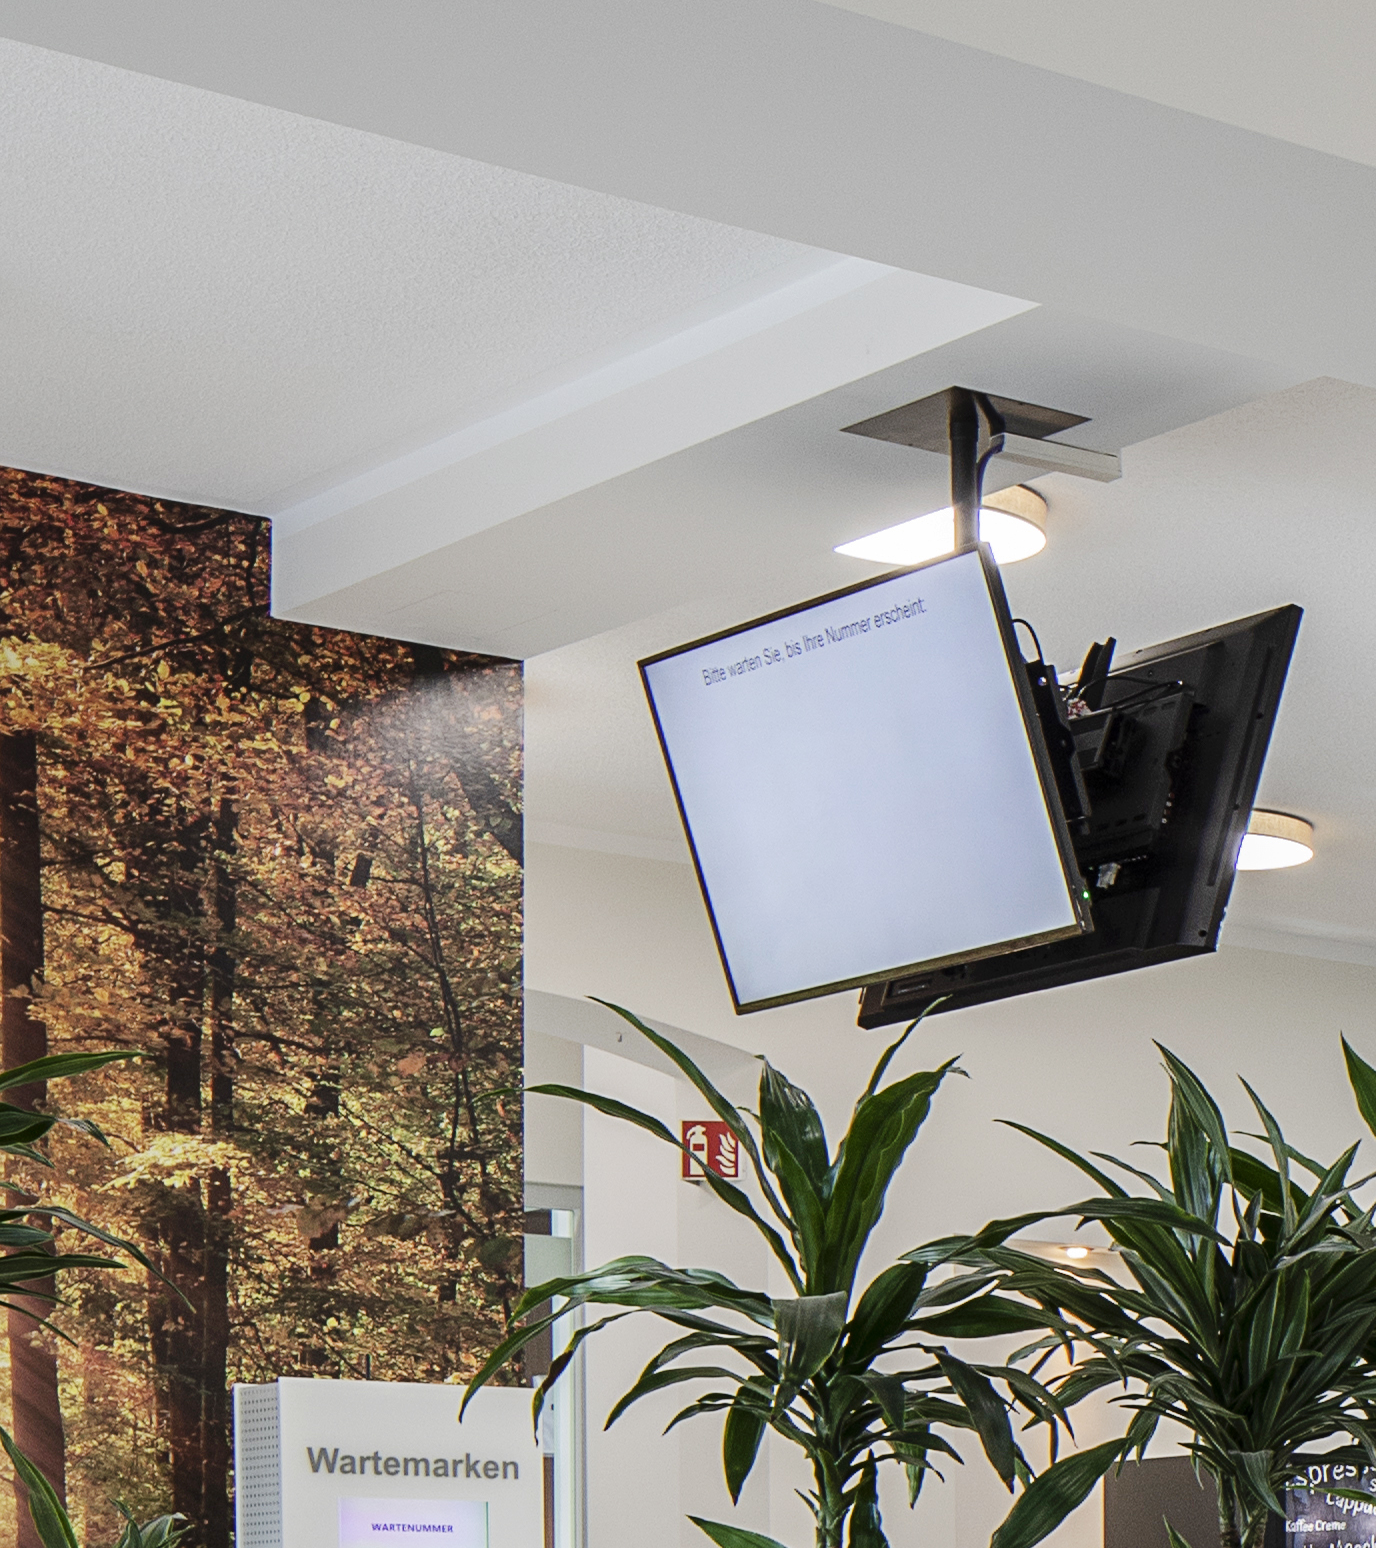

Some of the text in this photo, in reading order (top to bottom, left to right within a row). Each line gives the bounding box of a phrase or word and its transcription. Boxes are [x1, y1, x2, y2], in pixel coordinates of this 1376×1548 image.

[702, 668, 727, 686] Bitte
[727, 654, 763, 678] warten
[762, 647, 785, 666] Sie,
[784, 638, 802, 659] bis
[802, 634, 825, 653] Ihre
[824, 617, 872, 643] Nummer
[306, 1446, 519, 1480] Wartemarken
[371, 1523, 454, 1533] WARTENUMMER
[1285, 1519, 1314, 1533] Kaffee
